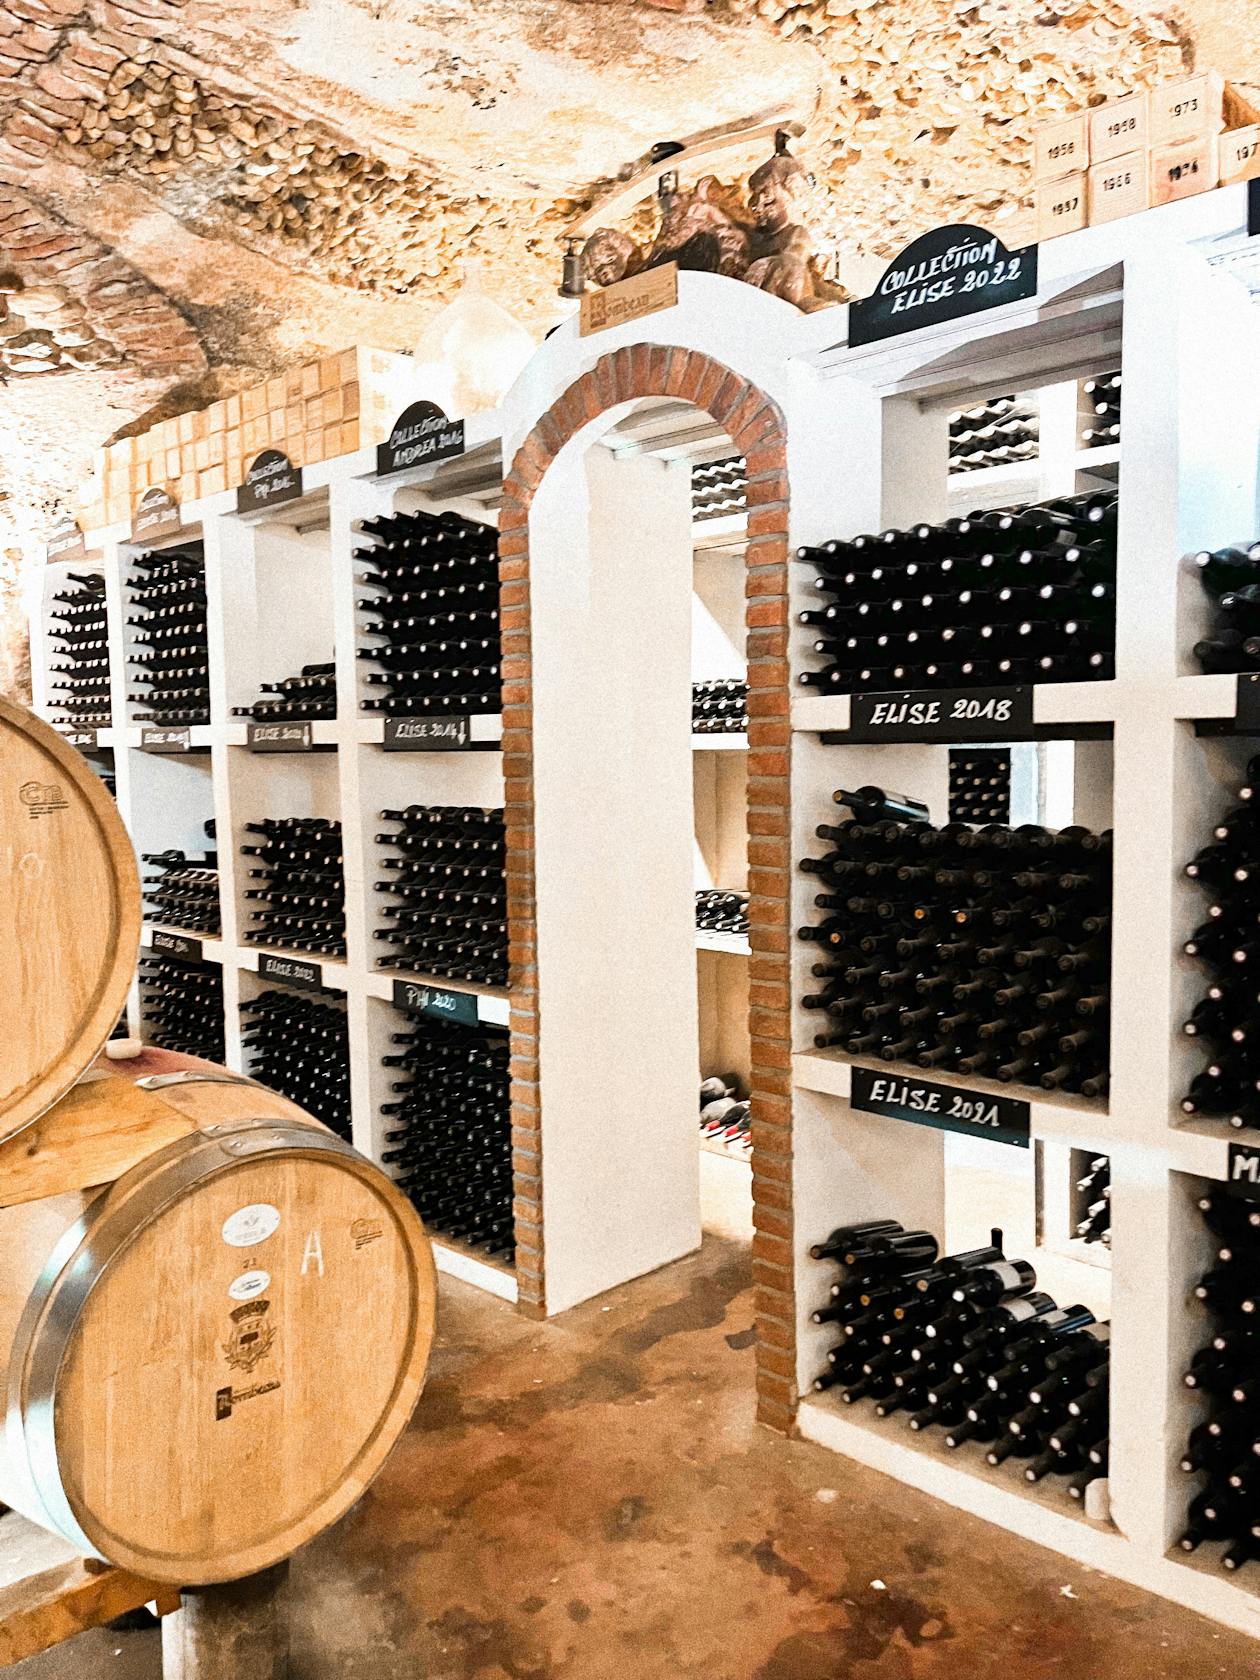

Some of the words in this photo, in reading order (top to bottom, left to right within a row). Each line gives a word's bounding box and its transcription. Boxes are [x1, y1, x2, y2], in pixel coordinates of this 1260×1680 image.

[958, 258, 1023, 294] 2022
[949, 698, 1013, 722] 2018
[301, 1230, 325, 1277] A
